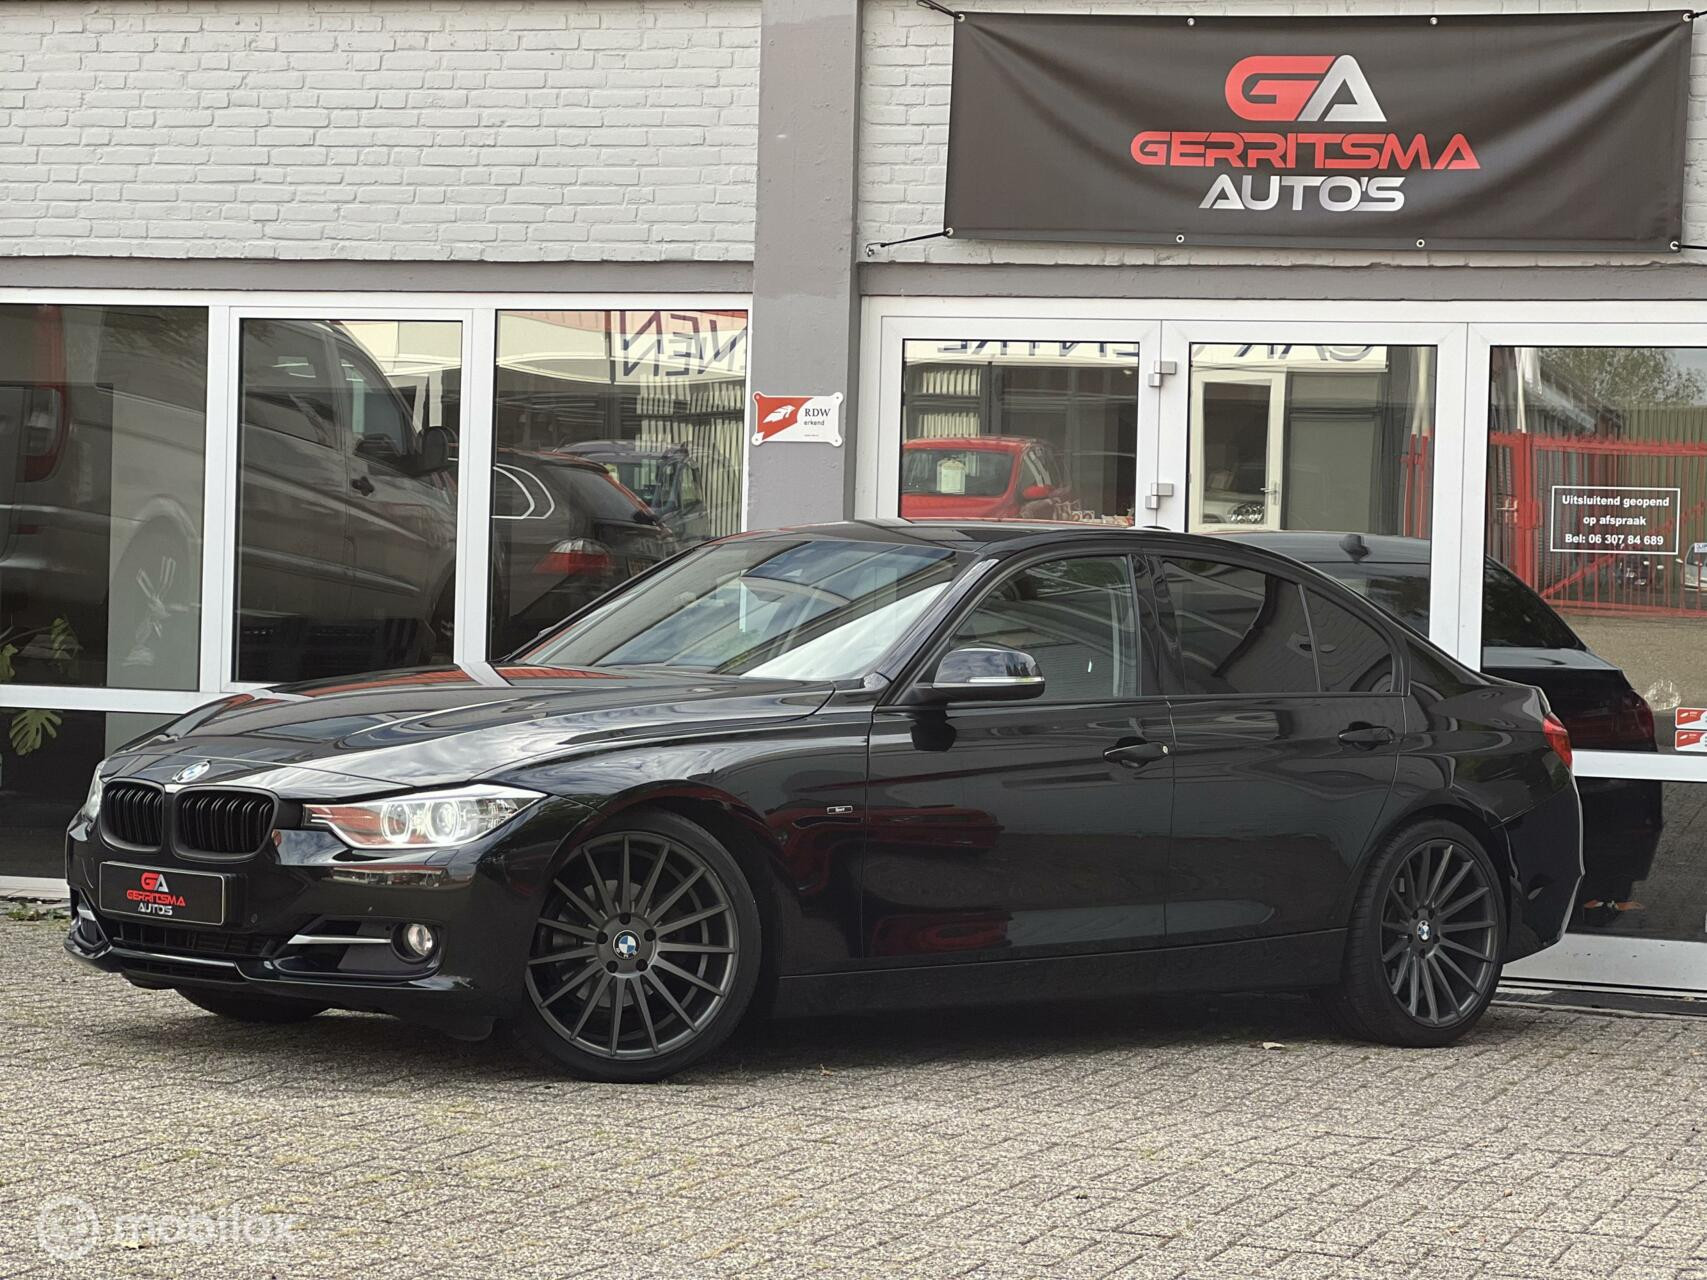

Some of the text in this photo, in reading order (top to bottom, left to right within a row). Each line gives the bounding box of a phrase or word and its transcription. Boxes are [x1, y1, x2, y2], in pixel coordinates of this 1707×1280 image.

[1225, 54, 1387, 122] GA
[1130, 131, 1481, 170] GERRITSMA
[1198, 174, 1406, 212] AUTO'S
[804, 408, 831, 417] RDW
[803, 418, 825, 426] erkend
[1561, 495, 1670, 508] Uitsluitend geopend
[1583, 515, 1647, 527] op afspraak
[1565, 533, 1664, 545] Bel: 06 307 84 689
[141, 872, 169, 893] GA
[126, 889, 186, 907] GERRITSMA
